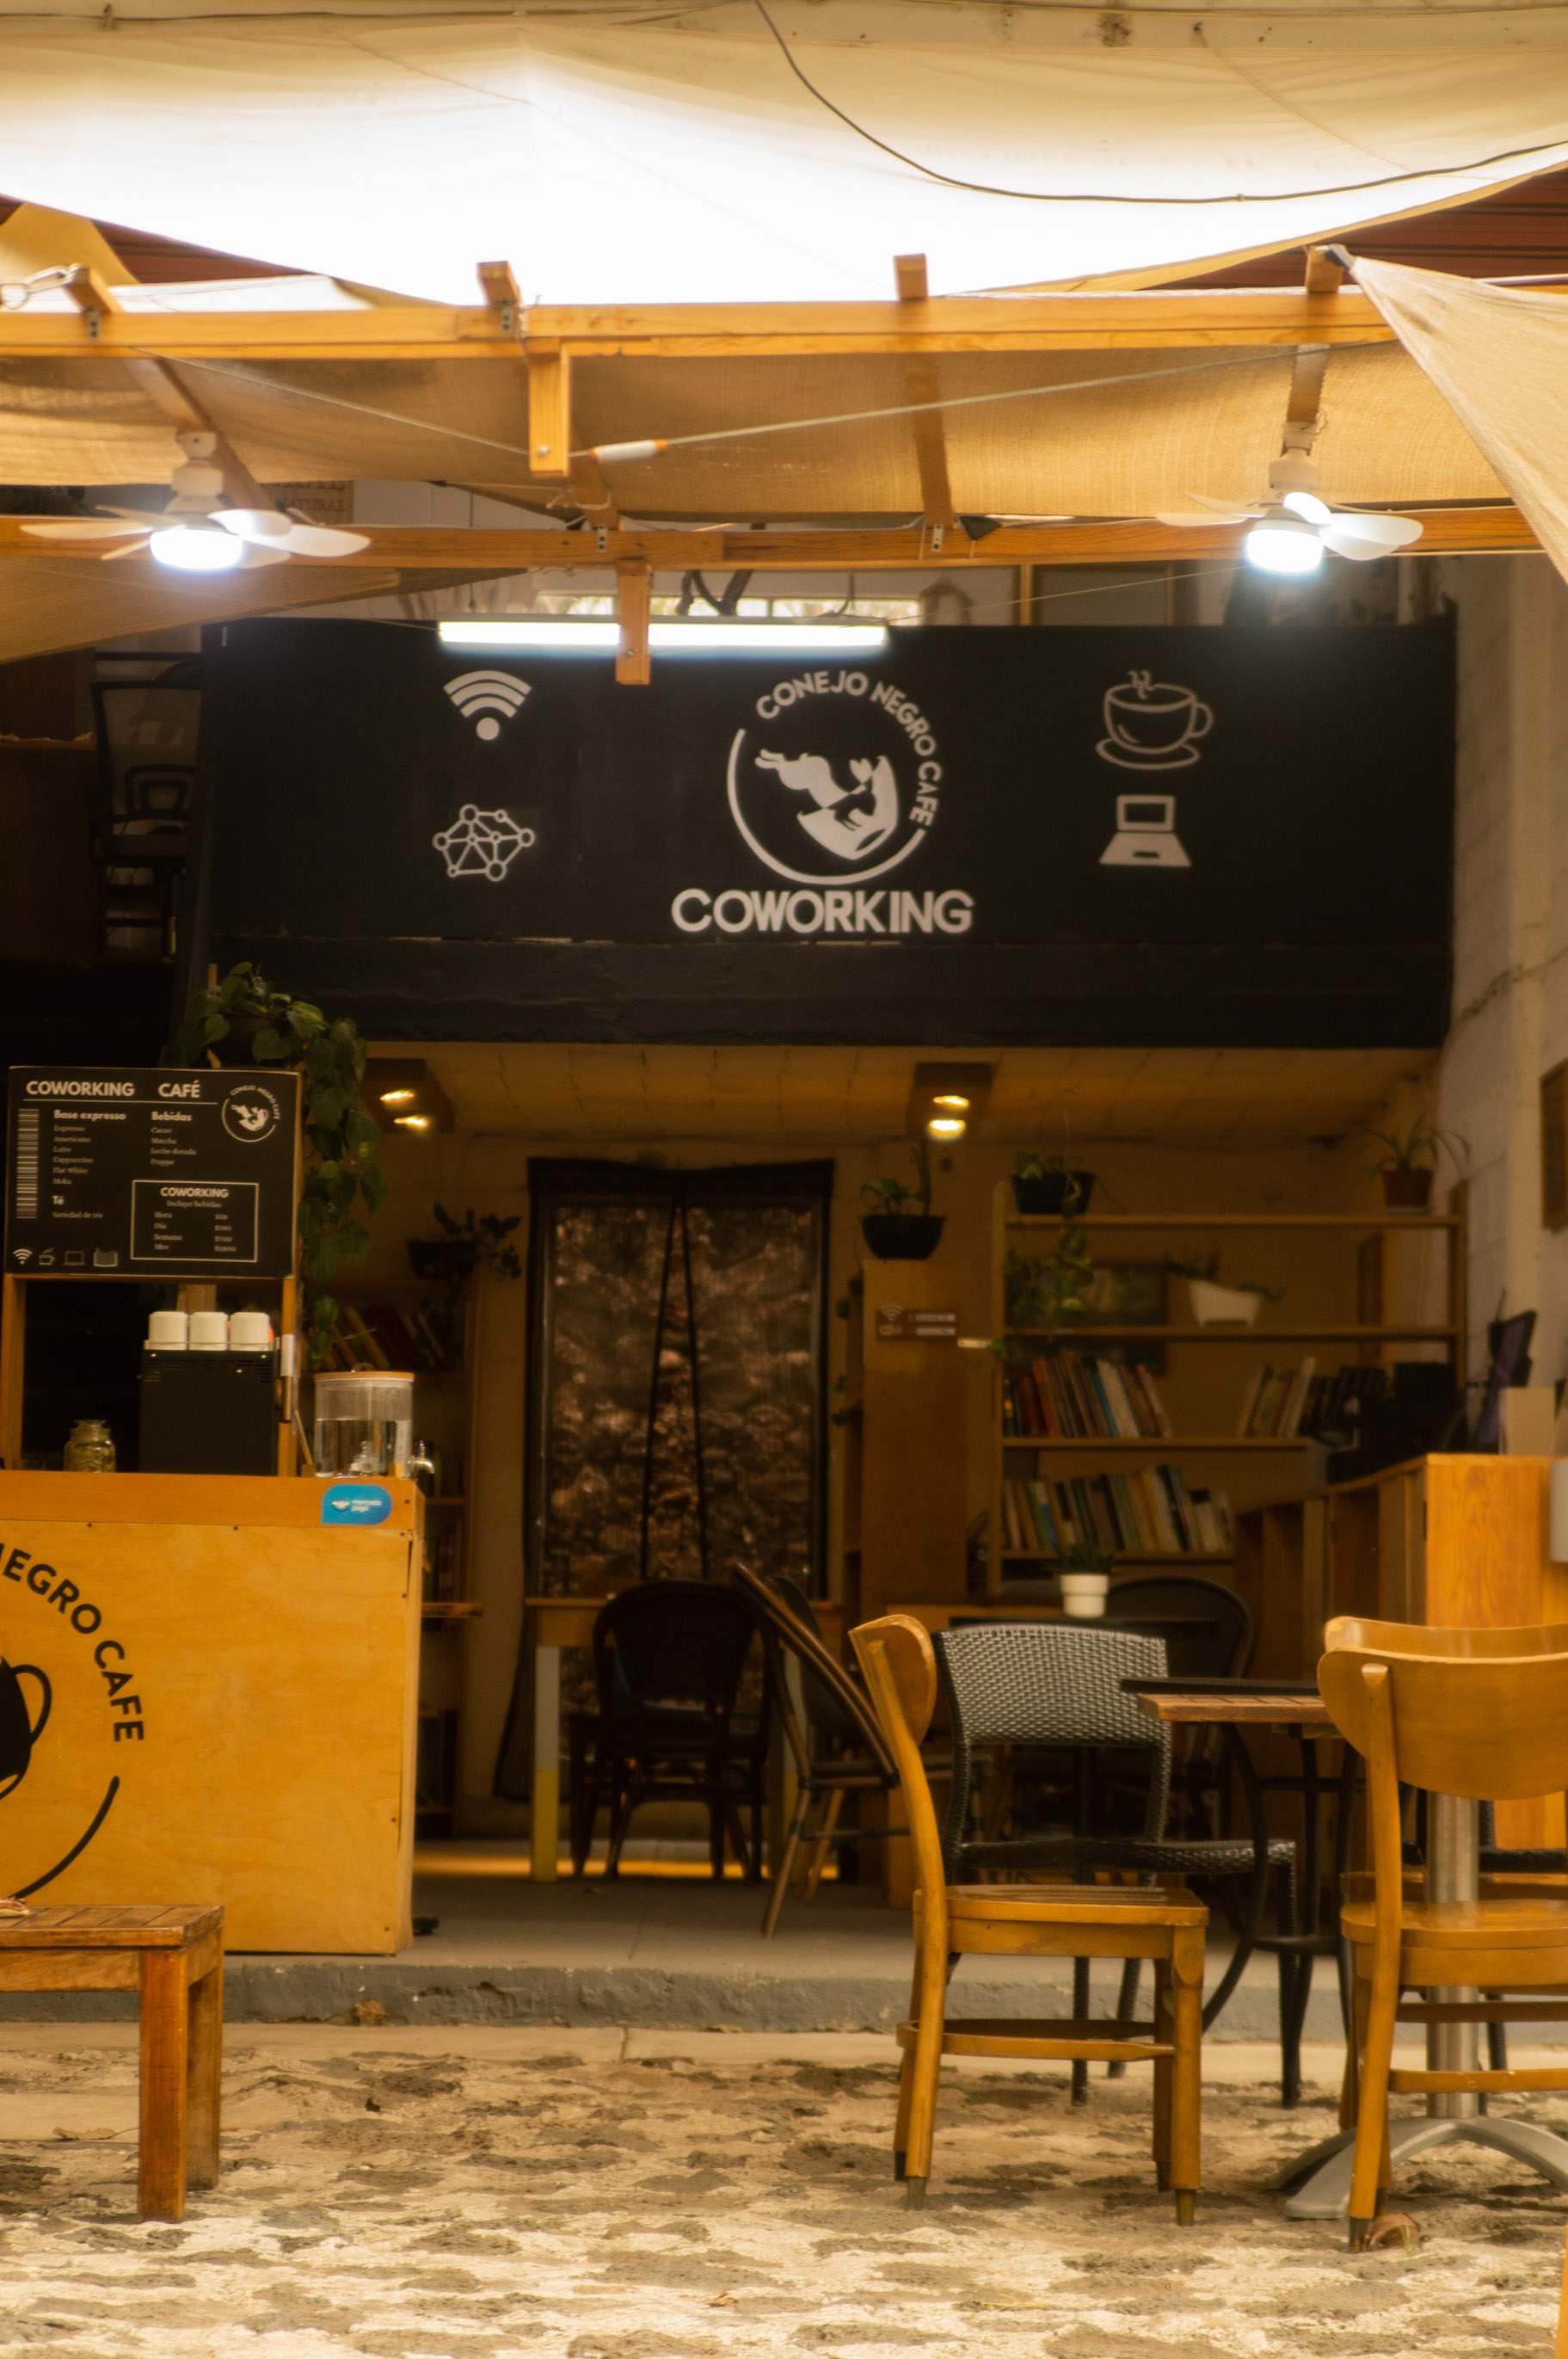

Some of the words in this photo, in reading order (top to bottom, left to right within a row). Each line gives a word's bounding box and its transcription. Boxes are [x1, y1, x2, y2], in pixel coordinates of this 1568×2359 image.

[756, 670, 870, 719] CONEJO
[870, 681, 937, 757] NEGRO
[908, 761, 943, 828] CAFE
[671, 888, 975, 934] COWORKING
[26, 1080, 136, 1097] COWORKING
[157, 1080, 201, 1099] CAFÉ
[53, 1109, 78, 1120] Base
[80, 1112, 126, 1123] expresso
[151, 1111, 193, 1122] Bebidas
[52, 1195, 65, 1205] Té
[160, 1187, 230, 1198] COWORKING
[0, 1543, 102, 1635] EGRO
[93, 1640, 145, 1742] CAFE
